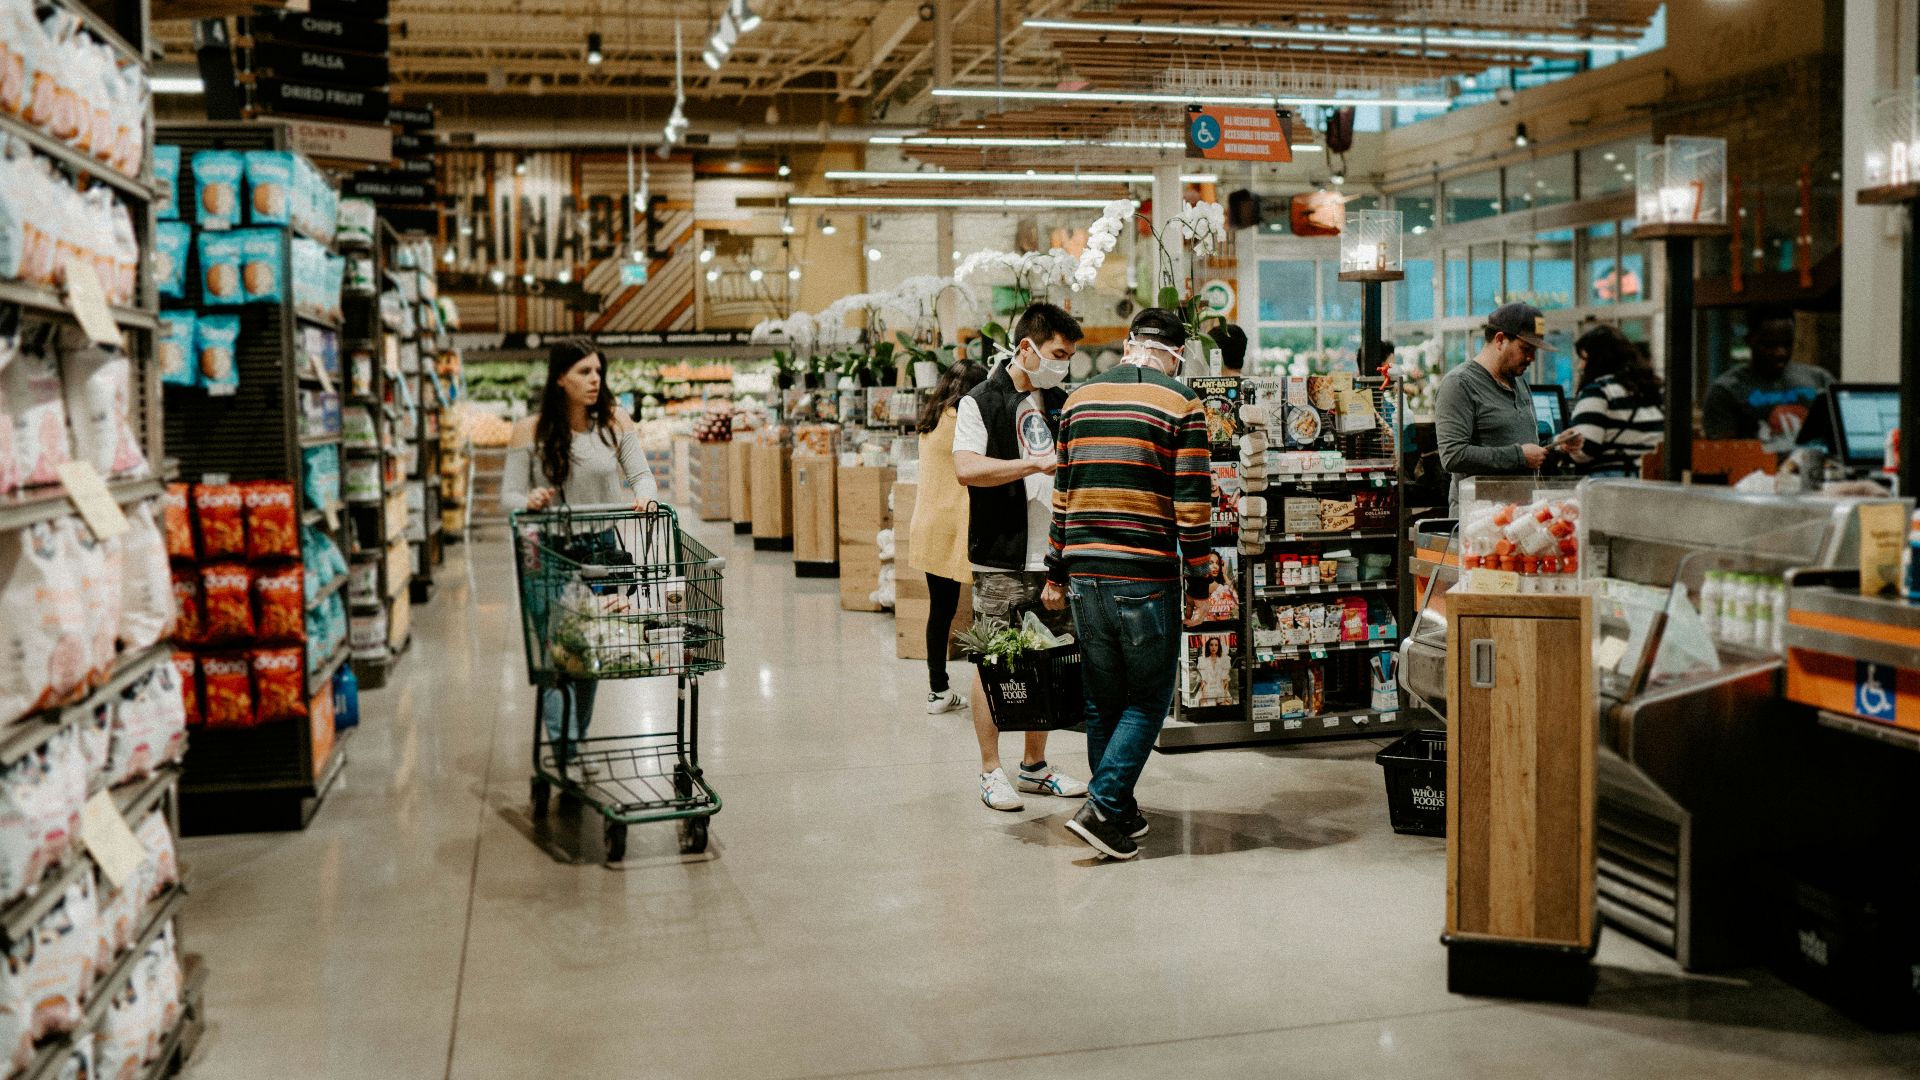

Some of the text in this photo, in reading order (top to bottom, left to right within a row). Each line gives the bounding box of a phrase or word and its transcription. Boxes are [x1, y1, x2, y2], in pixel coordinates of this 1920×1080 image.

[302, 17, 343, 36] CHIPS
[302, 52, 345, 70] SALSA
[281, 84, 365, 106] DRIED FRUIT
[1689, 180, 1705, 222] 7
[1193, 380, 1238, 389] PLANT-BASED
[1211, 466, 1237, 479] URNAL
[197, 491, 242, 509] dang
[246, 491, 291, 509] dang
[1332, 503, 1349, 514] dang
[1332, 517, 1349, 528] dang
[203, 572, 248, 590] dang
[256, 574, 298, 593] dang
[203, 658, 248, 678] dang
[254, 654, 297, 672] dang
[1000, 682, 1027, 691] WHOLE
[1002, 690, 1028, 699] FOODS
[1411, 787, 1446, 799] WHOLE
[1413, 797, 1445, 807] FOODS
